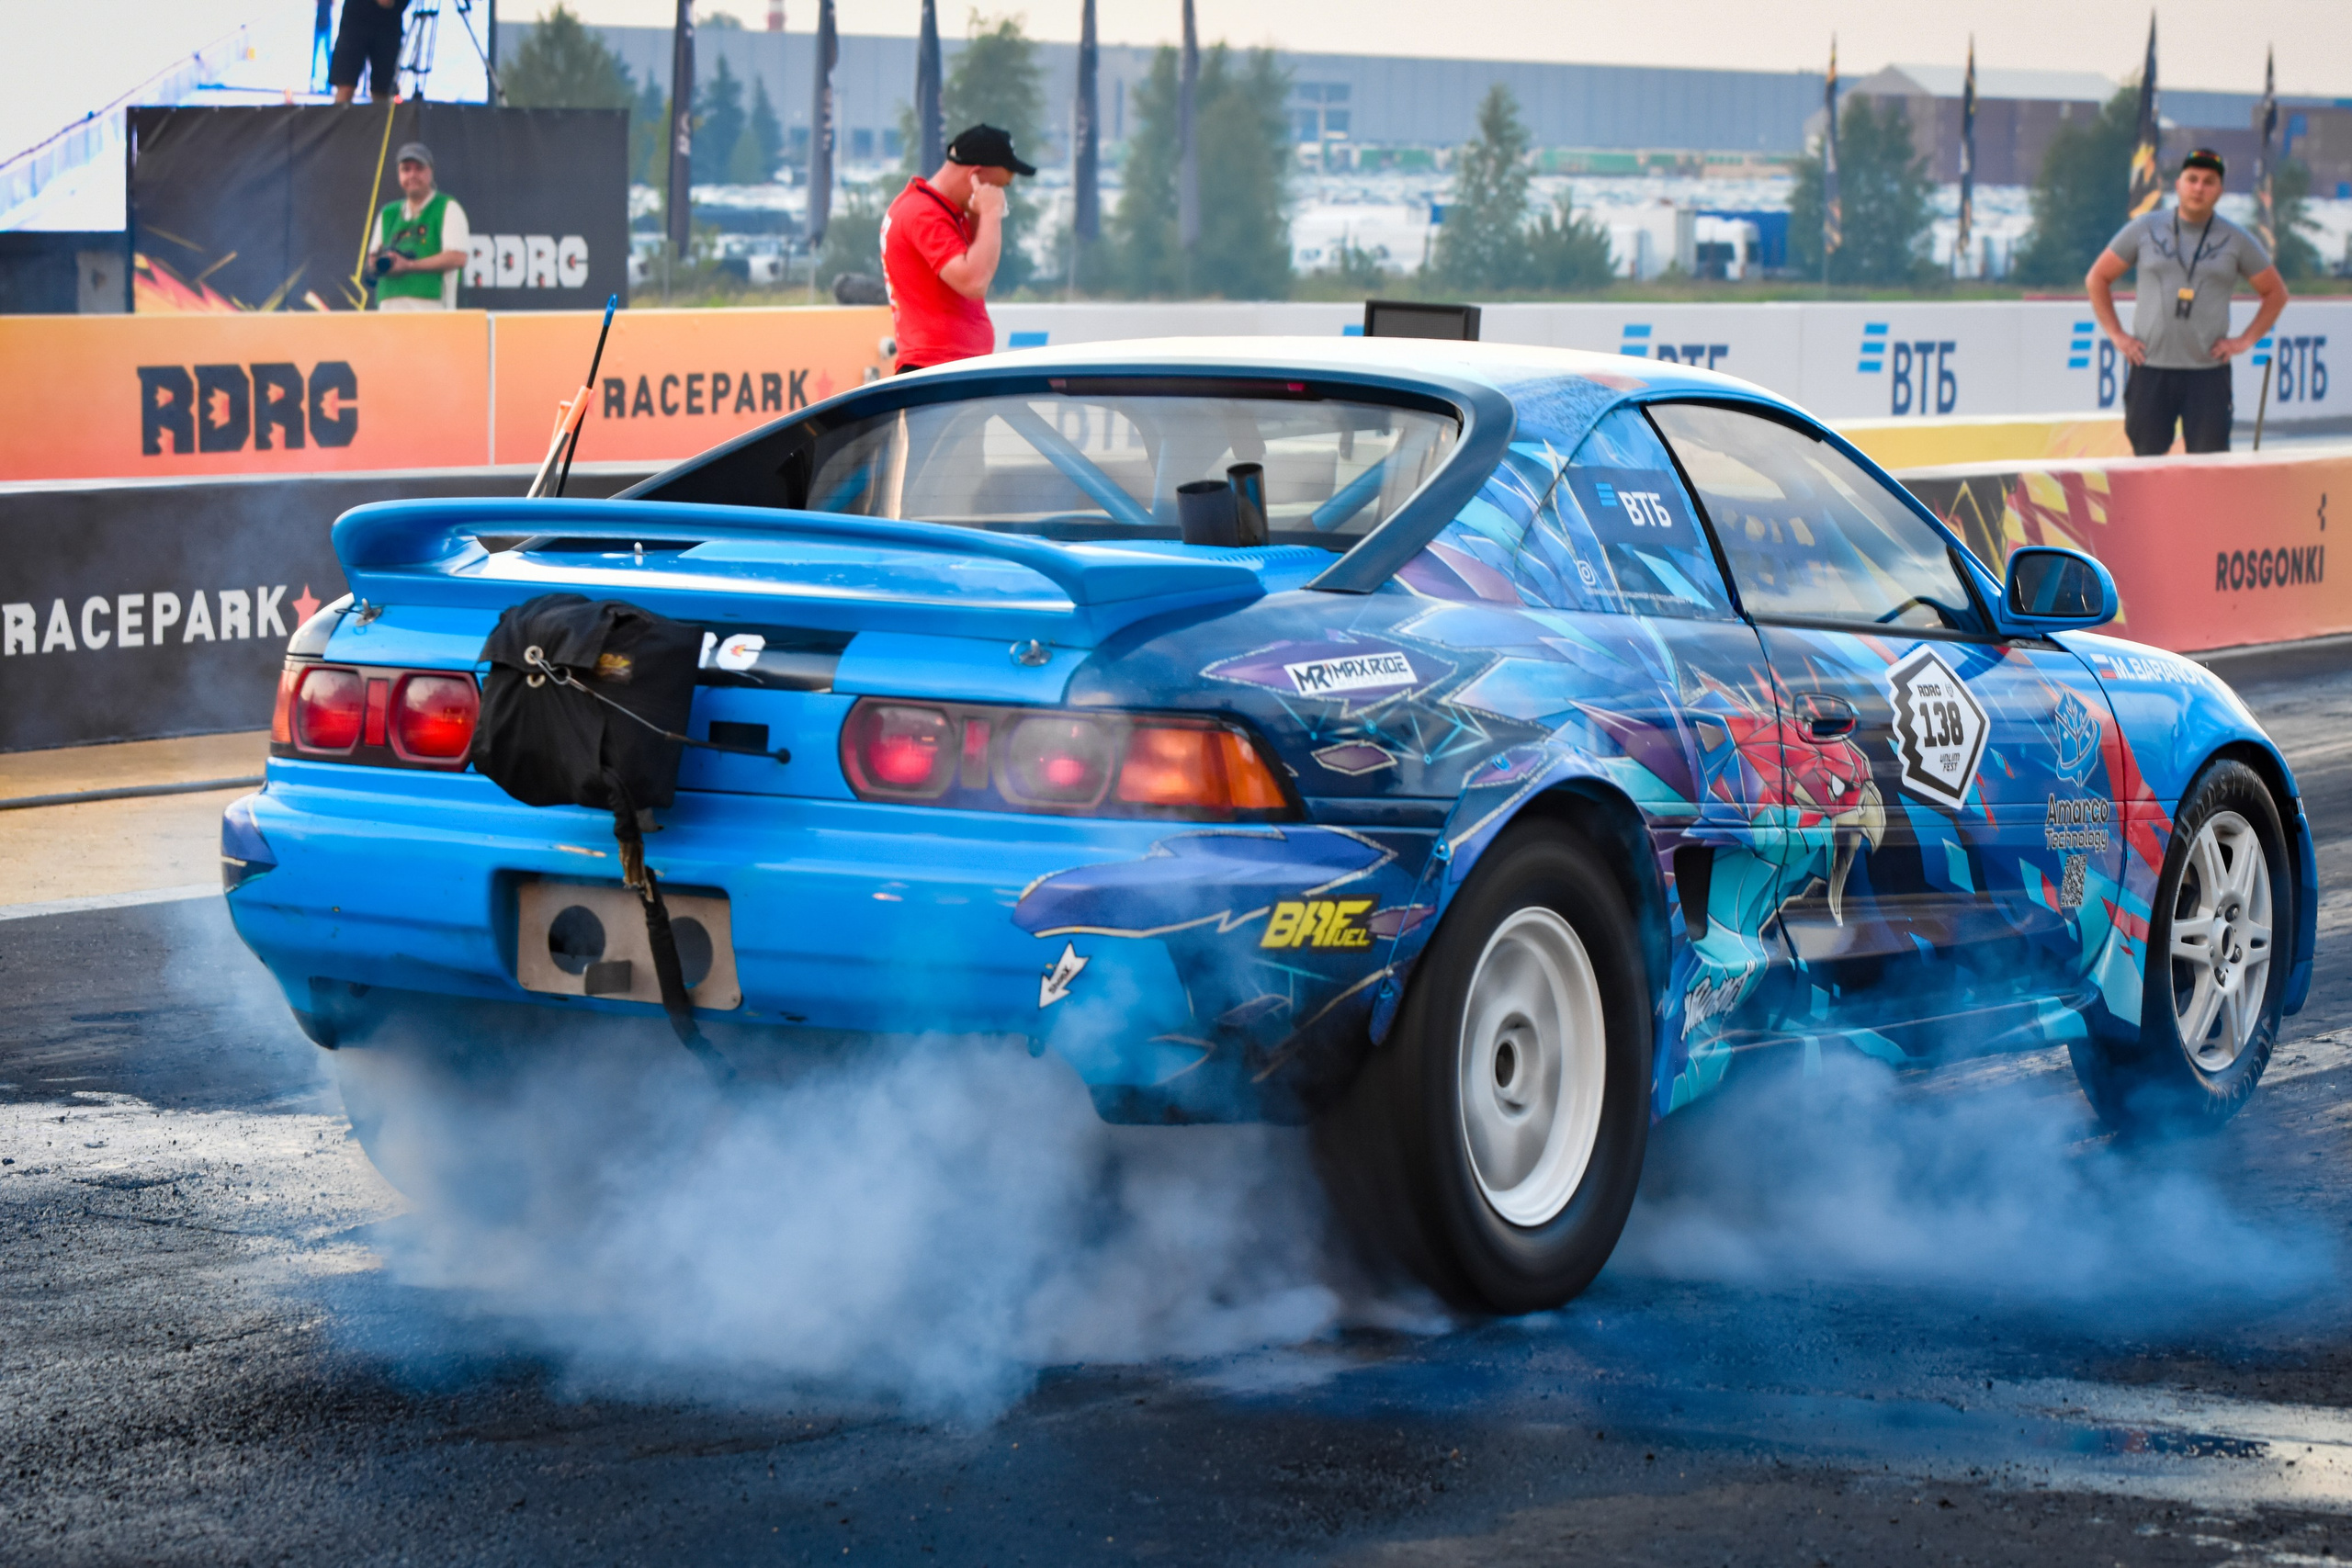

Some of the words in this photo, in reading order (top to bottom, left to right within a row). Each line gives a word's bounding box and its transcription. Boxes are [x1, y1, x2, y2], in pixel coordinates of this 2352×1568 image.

[464, 235, 588, 288] RDRC
[603, 369, 809, 419] RACEPARK
[1892, 341, 1956, 416] ВТБ
[2277, 336, 2327, 402] ВТБ
[136, 361, 357, 456] RDRC
[1618, 491, 1672, 527] ВТБ
[2215, 545, 2324, 592] ROSGONKI
[2, 584, 288, 656] RACEPARK
[1919, 701, 1963, 748] 138
[2044, 793, 2109, 827] Amarco
[2044, 825, 2109, 853] Technology
